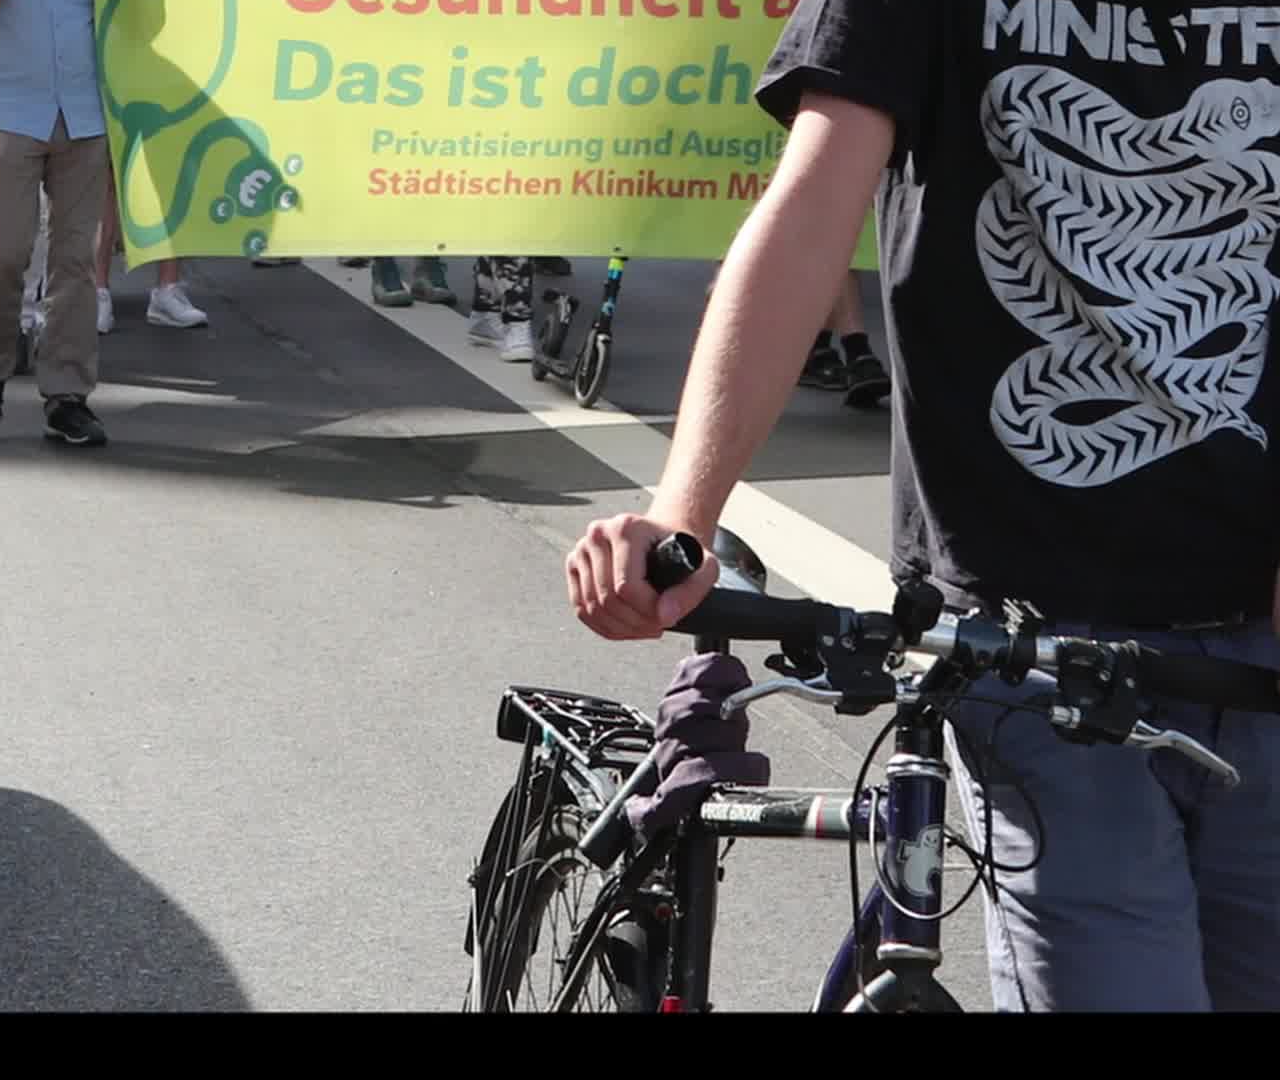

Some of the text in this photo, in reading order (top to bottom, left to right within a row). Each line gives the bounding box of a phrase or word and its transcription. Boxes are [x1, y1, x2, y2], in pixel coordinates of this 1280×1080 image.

[273, 39, 753, 109] Das ist doch
[372, 128, 603, 163] Privatisierung
[613, 129, 673, 157] und
[368, 168, 562, 196] Städtischen
[571, 169, 717, 199] Klinikum
